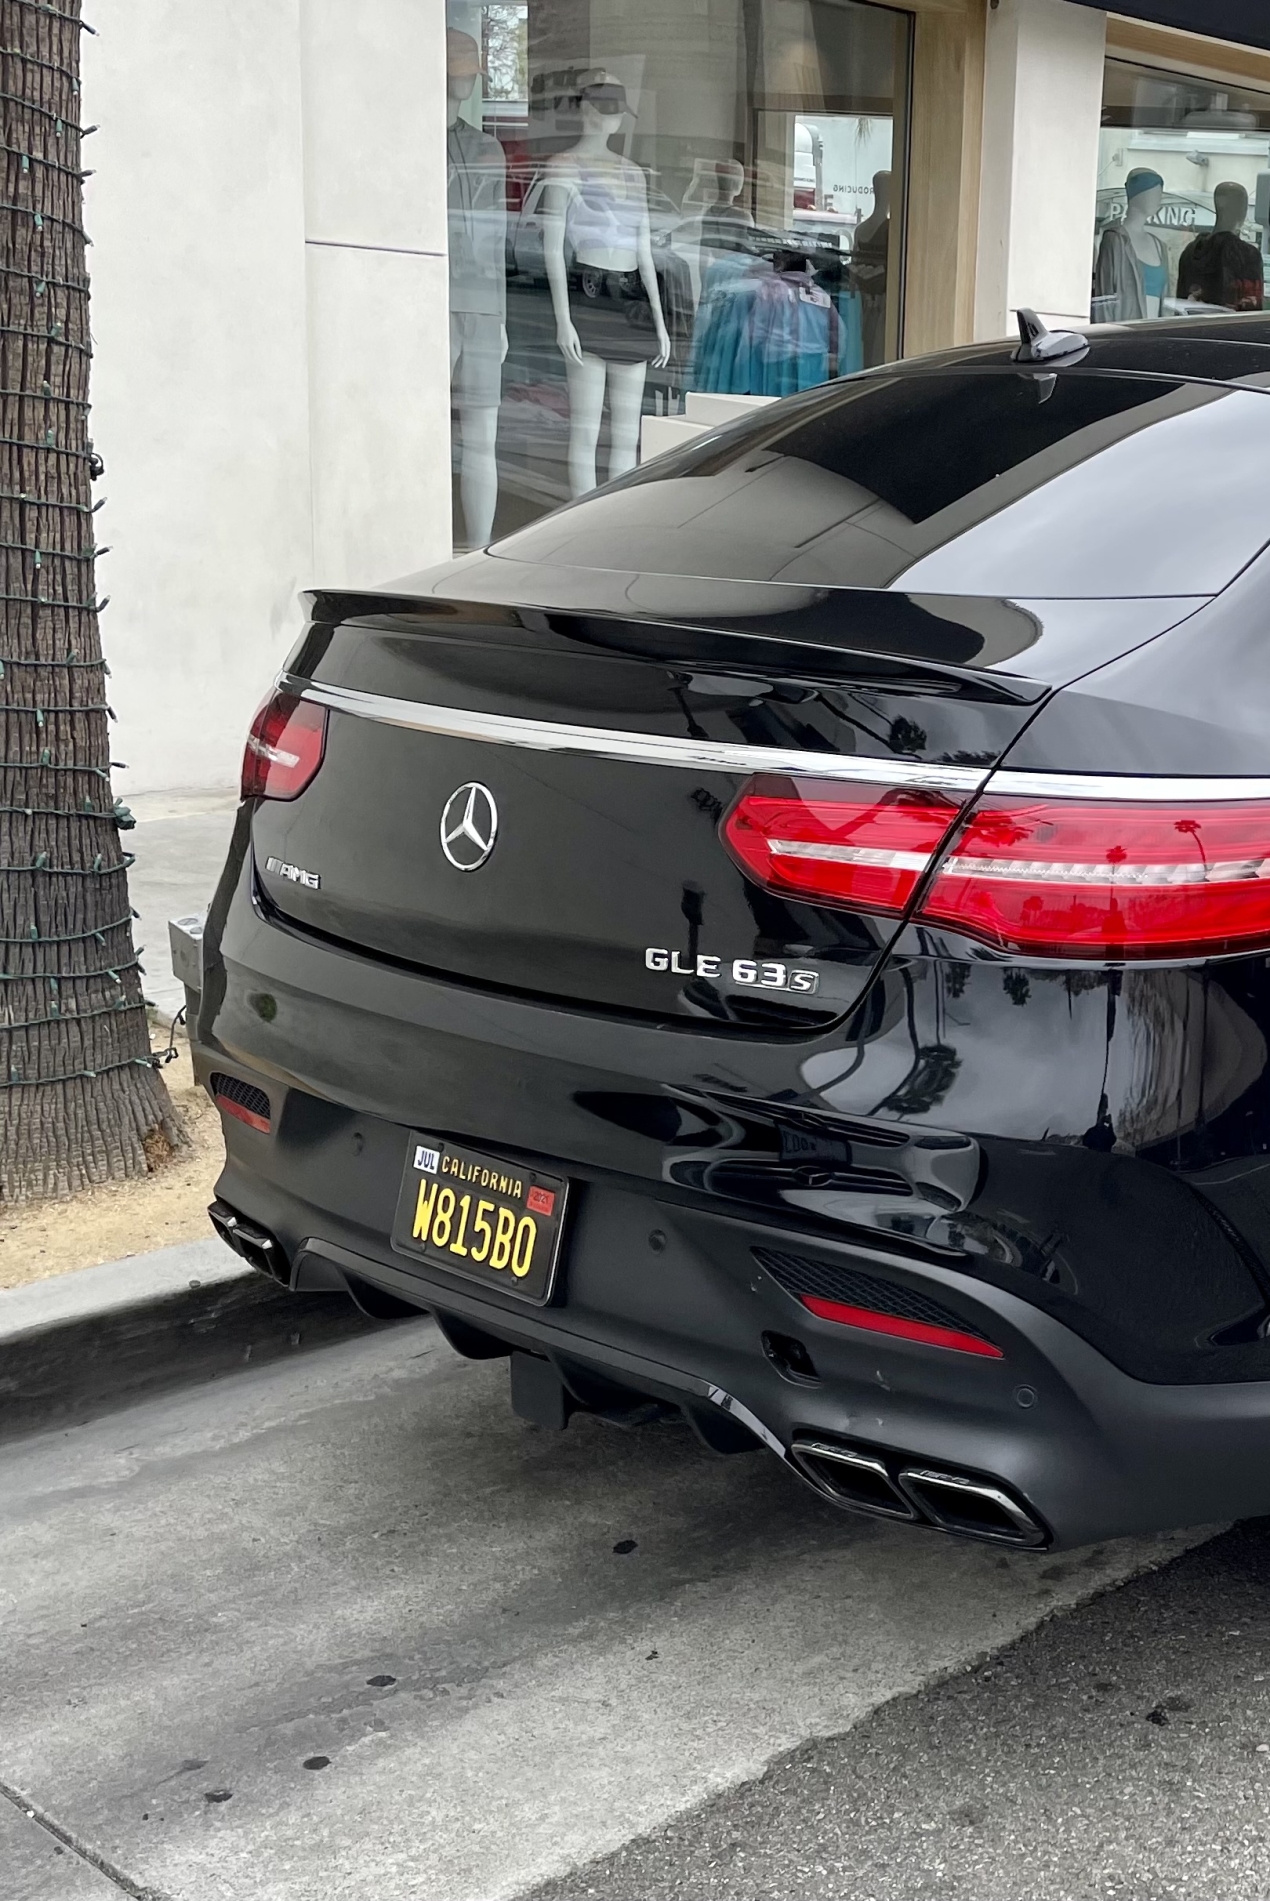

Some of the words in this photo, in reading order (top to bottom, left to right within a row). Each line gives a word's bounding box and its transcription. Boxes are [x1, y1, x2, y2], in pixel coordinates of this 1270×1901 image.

[278, 861, 321, 890] AMG
[645, 947, 722, 978] GLE
[417, 1150, 436, 1171] JUL
[441, 1156, 523, 1198] CALIFORNIA
